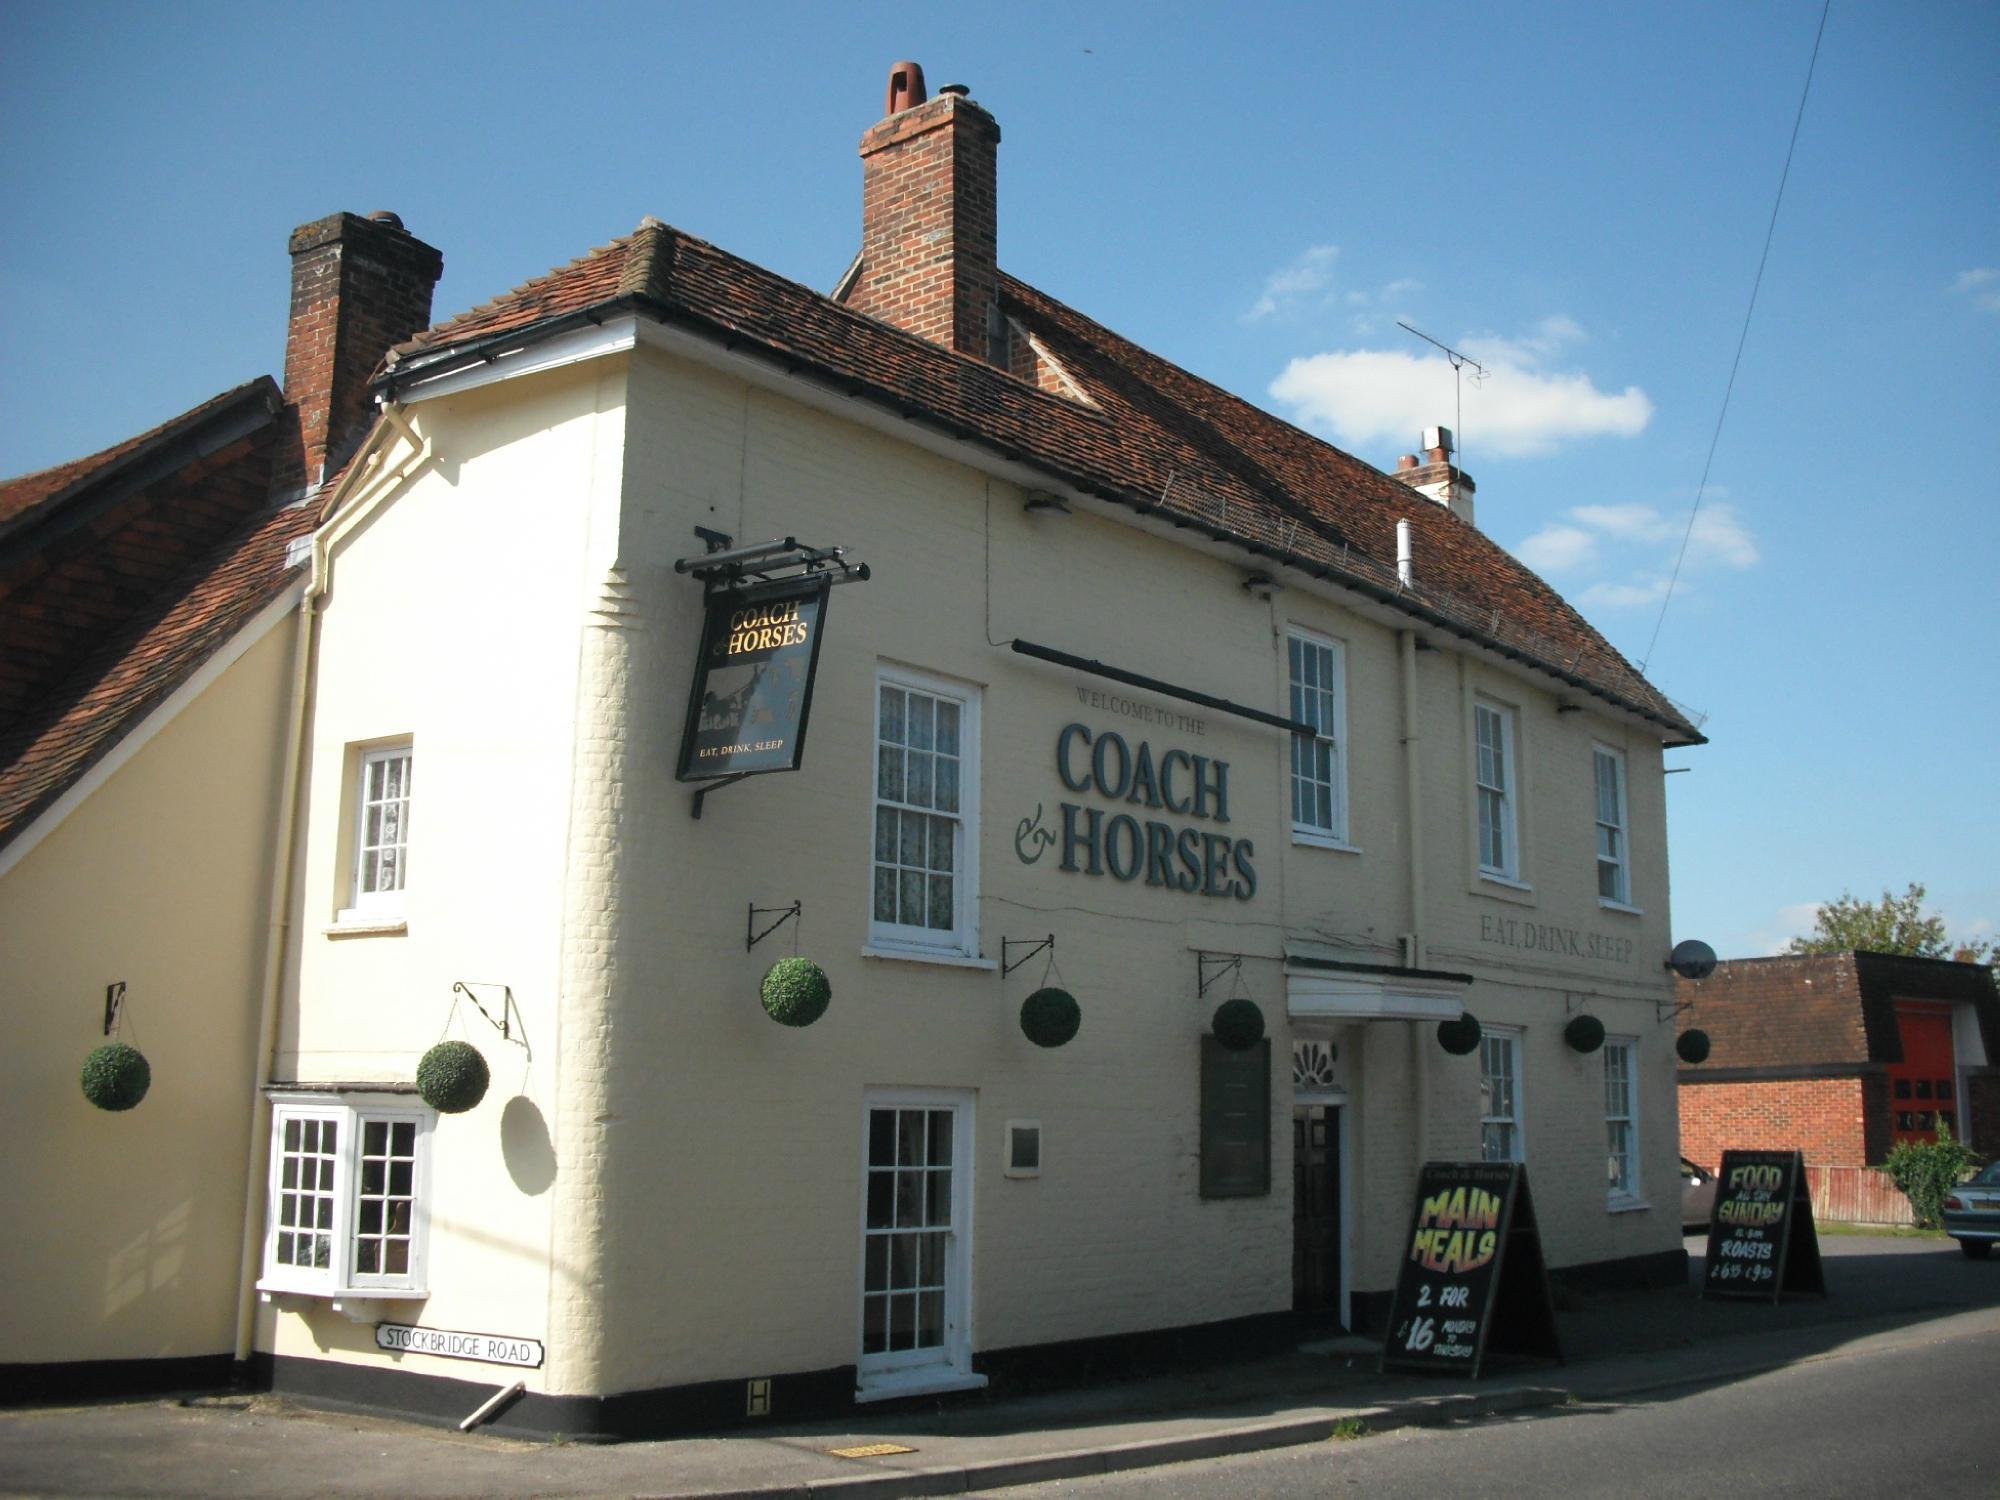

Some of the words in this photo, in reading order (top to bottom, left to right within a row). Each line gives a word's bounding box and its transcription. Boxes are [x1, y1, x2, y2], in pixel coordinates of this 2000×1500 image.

[730, 601, 800, 632] COACH
[728, 622, 808, 655] HORSES
[1076, 687, 1153, 722] WELCOME
[1155, 708, 1174, 726] TO
[1177, 715, 1206, 736] THE
[755, 739, 784, 751] SLEEP
[1057, 723, 1231, 822] COACH
[1015, 802, 1056, 864] &
[1058, 802, 1257, 901] HORSES
[1588, 932, 1632, 963] SLEEP
[1729, 1165, 1783, 1190] FOOD
[1418, 1186, 1500, 1229] MAIN
[1718, 1201, 1785, 1227] SUNDAY
[1410, 1229, 1497, 1274] MEALS
[1720, 1239, 1773, 1259] ROASTS
[1417, 1284, 1432, 1307] 2
[1439, 1286, 1470, 1308] FOR
[1441, 1320, 1476, 1334] MONDAY
[387, 1328, 480, 1355] STOCKBRIDGE
[488, 1340, 530, 1361] ROAD
[750, 1382, 767, 1412] H
